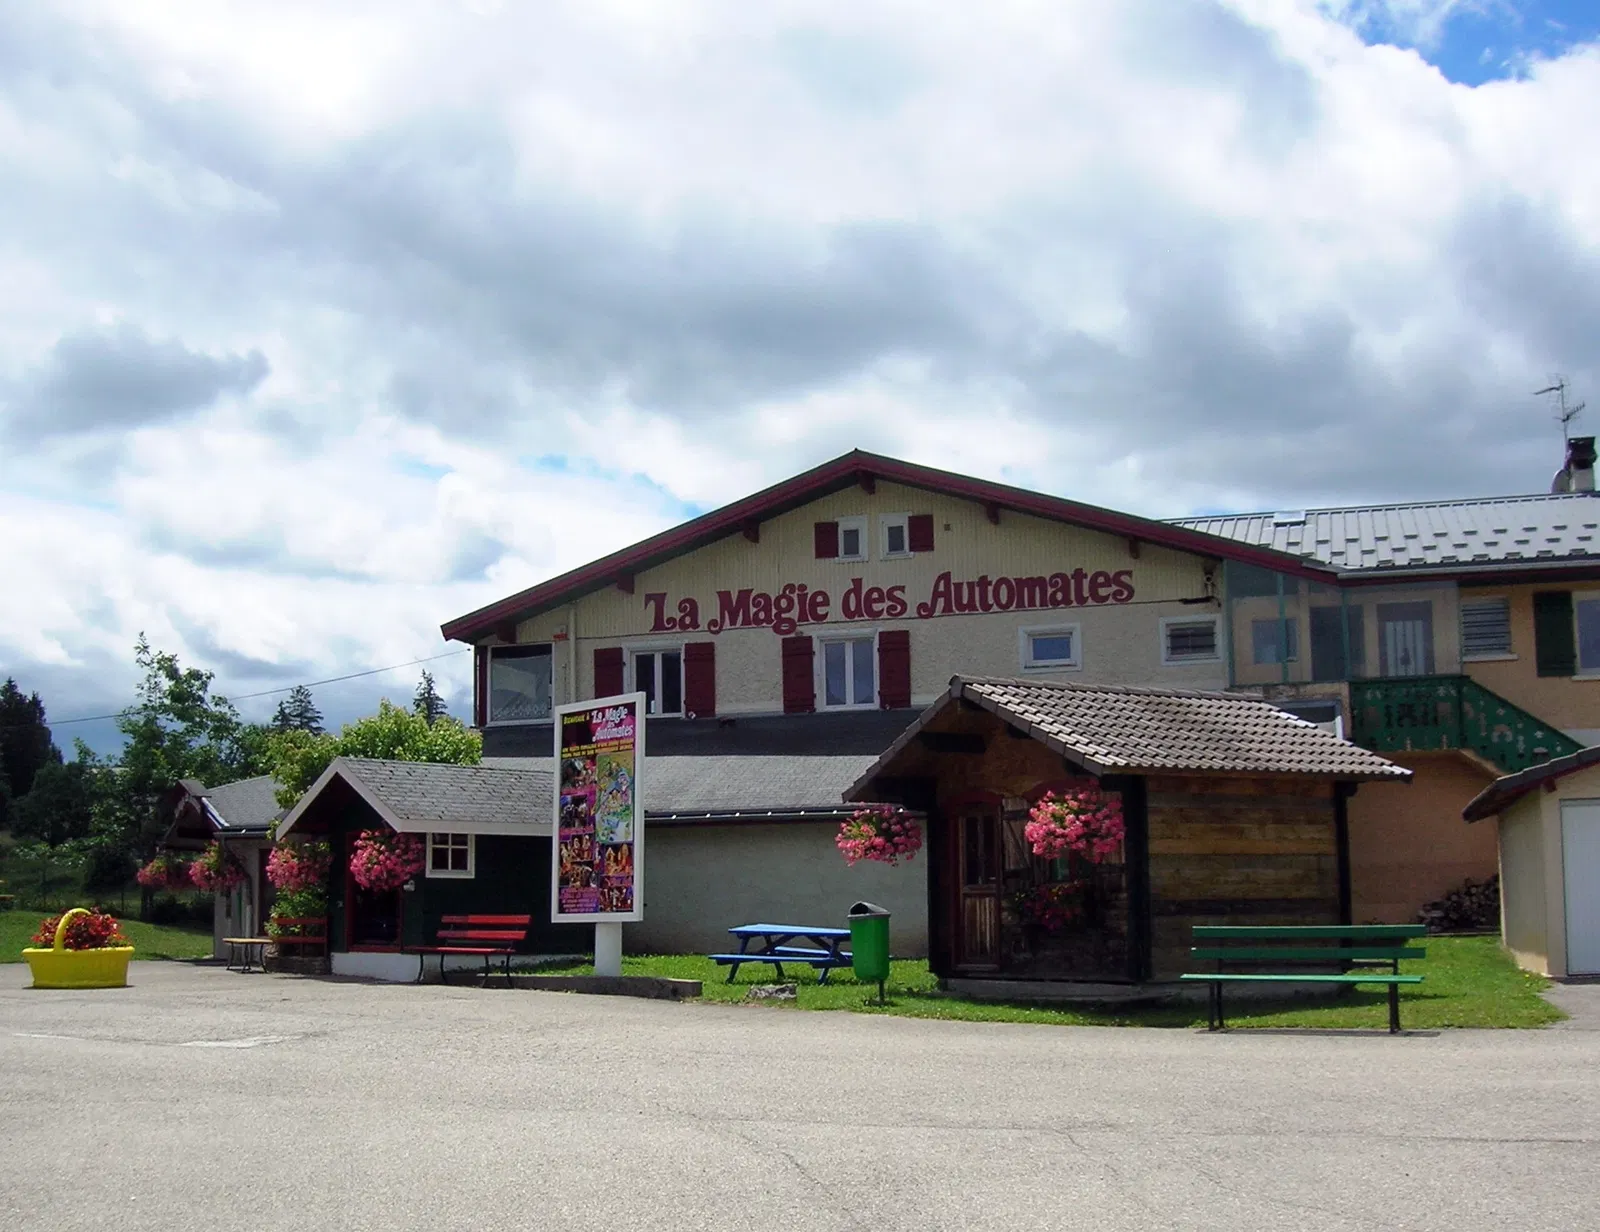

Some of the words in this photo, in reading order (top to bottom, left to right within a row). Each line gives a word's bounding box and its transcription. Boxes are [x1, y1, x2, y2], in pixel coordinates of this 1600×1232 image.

[645, 592, 700, 632] La
[707, 583, 829, 636] Magie
[842, 578, 907, 620] des
[917, 569, 1135, 619] Automates
[591, 710, 603, 723] La
[603, 706, 628, 724] Magie
[592, 725, 634, 742] Automates
